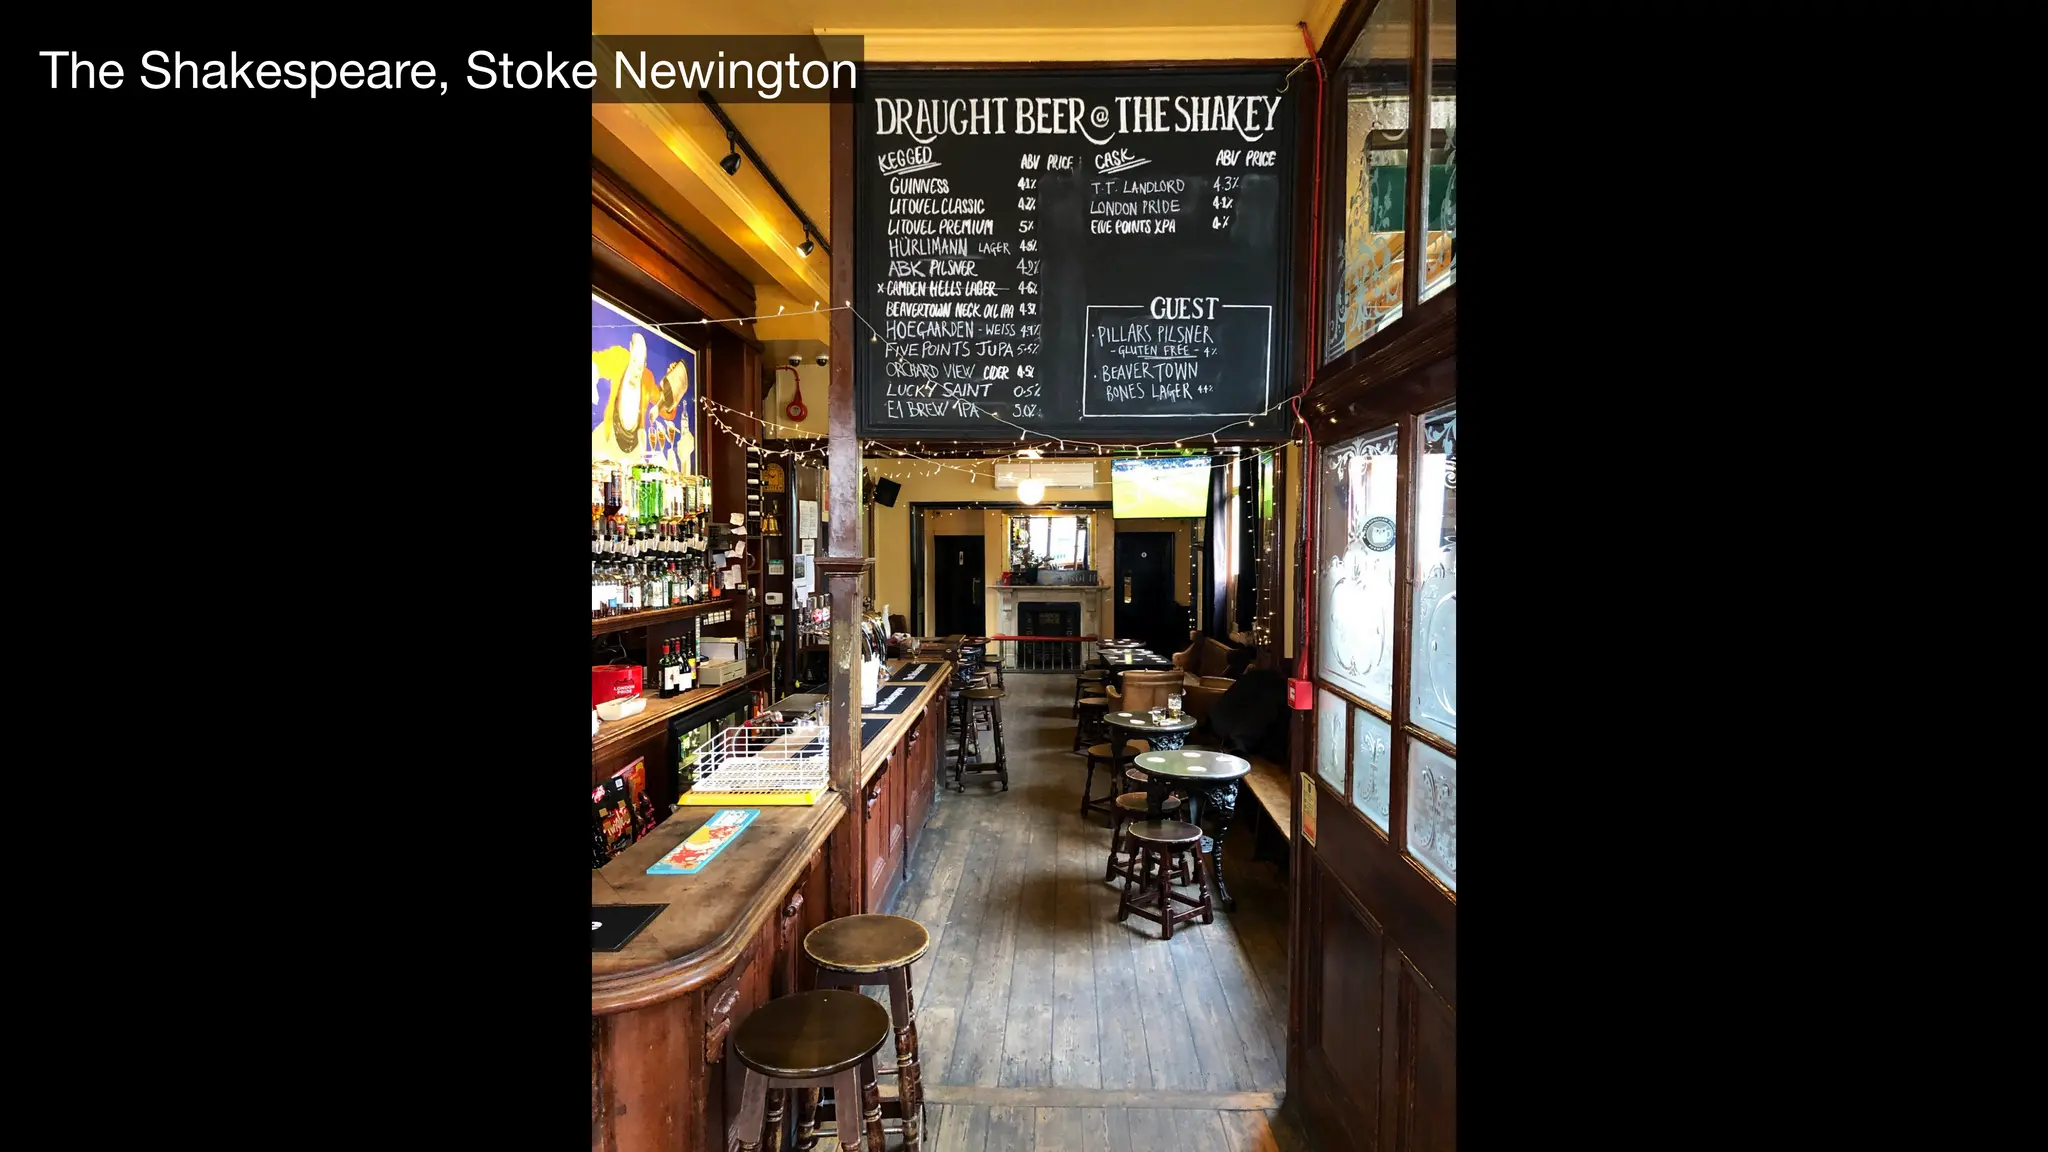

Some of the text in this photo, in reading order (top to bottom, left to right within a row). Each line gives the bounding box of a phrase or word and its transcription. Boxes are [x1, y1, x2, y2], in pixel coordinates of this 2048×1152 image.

[874, 95, 1282, 145] DRAUGHT BEER @ THE SHAKEY
[877, 146, 933, 173] KEGGED
[1020, 153, 1041, 170] ABV
[1094, 148, 1135, 170] CASK
[1215, 149, 1277, 167] ABV PRICE
[889, 176, 950, 195] GUINNESS
[1122, 178, 1185, 195] LANDLORD
[1213, 176, 1240, 192] 4.3%
[889, 198, 940, 215] LITOVEL
[940, 198, 985, 215] CLASSIC
[1090, 200, 1138, 216] LONDON
[1142, 199, 1181, 214] PRIDE
[888, 218, 936, 236] LITOVEL
[938, 218, 994, 235] PREMIUM
[1090, 219, 1113, 235] FIVE
[1115, 219, 1151, 235] POINTS
[1154, 218, 1176, 235] XPA
[888, 236, 968, 258] HÜRLIMANN
[978, 241, 1012, 256] LAGER
[888, 260, 927, 278] ABK
[929, 259, 979, 278] PILSNER
[886, 280, 927, 297] CAMDEN
[929, 280, 962, 298] HELLS
[964, 280, 999, 297] LAGER
[885, 301, 952, 319] BEAVERTOWN
[954, 303, 982, 318] NECK
[983, 303, 999, 319] OIL
[1000, 303, 1015, 319] IPA
[1150, 296, 1220, 320] GUEST
[886, 320, 974, 341] HOEGAARDEN
[985, 323, 1016, 337] WEISS
[1097, 323, 1214, 347] PILLARS PILSNER
[885, 341, 920, 358] FIVE
[921, 340, 971, 358] POINTS
[975, 340, 1014, 358] JUPA
[1118, 344, 1158, 359] GLUTEN
[1163, 344, 1189, 357] FREE
[885, 361, 939, 379] ORCHARD
[942, 363, 976, 379] VIEW
[983, 365, 1010, 380] CIDER
[1102, 361, 1199, 383] BEAVERTOWN
[886, 380, 1041, 398] LUCKY SAINT 0.5%
[1106, 382, 1145, 402] BONES
[1151, 382, 1193, 403] LAGER
[906, 400, 949, 418] BREW
